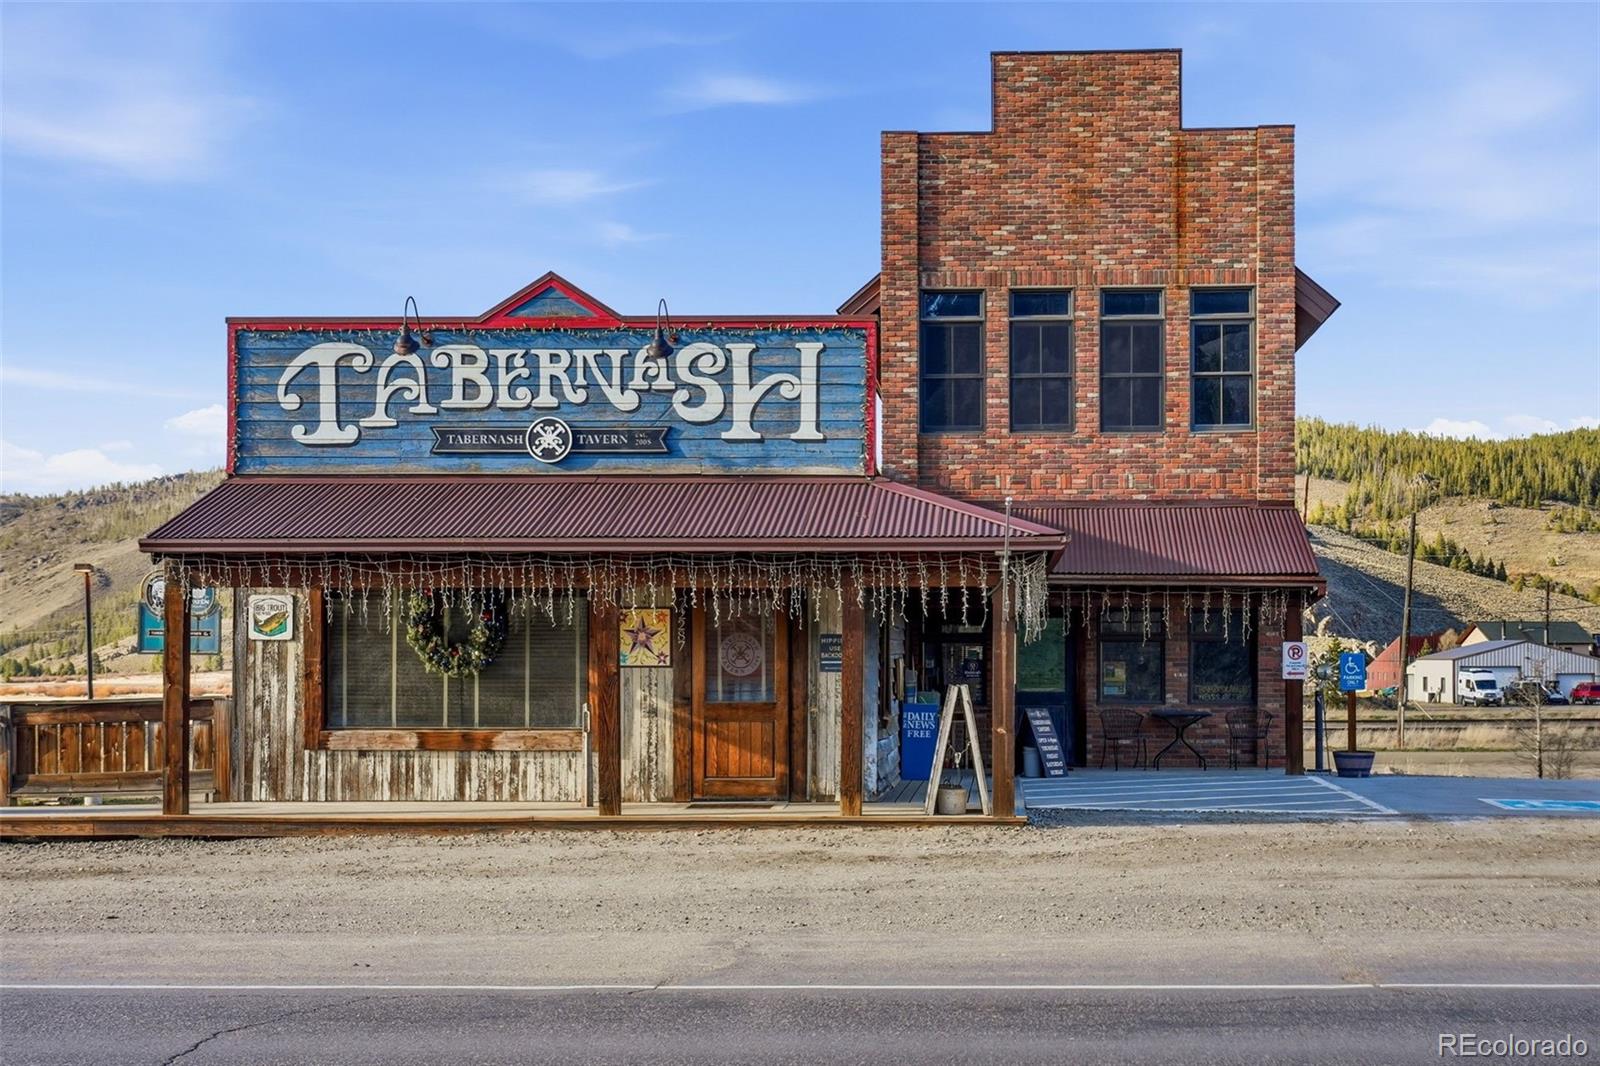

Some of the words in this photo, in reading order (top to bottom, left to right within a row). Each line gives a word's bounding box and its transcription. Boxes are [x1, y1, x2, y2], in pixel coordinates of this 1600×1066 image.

[277, 342, 825, 445] TABERNASH
[446, 434, 524, 445] TABERNASH
[577, 433, 628, 445] TAVERN
[907, 712, 936, 721] DAILY
[907, 720, 936, 729] NEWS
[907, 729, 931, 738] FREE
